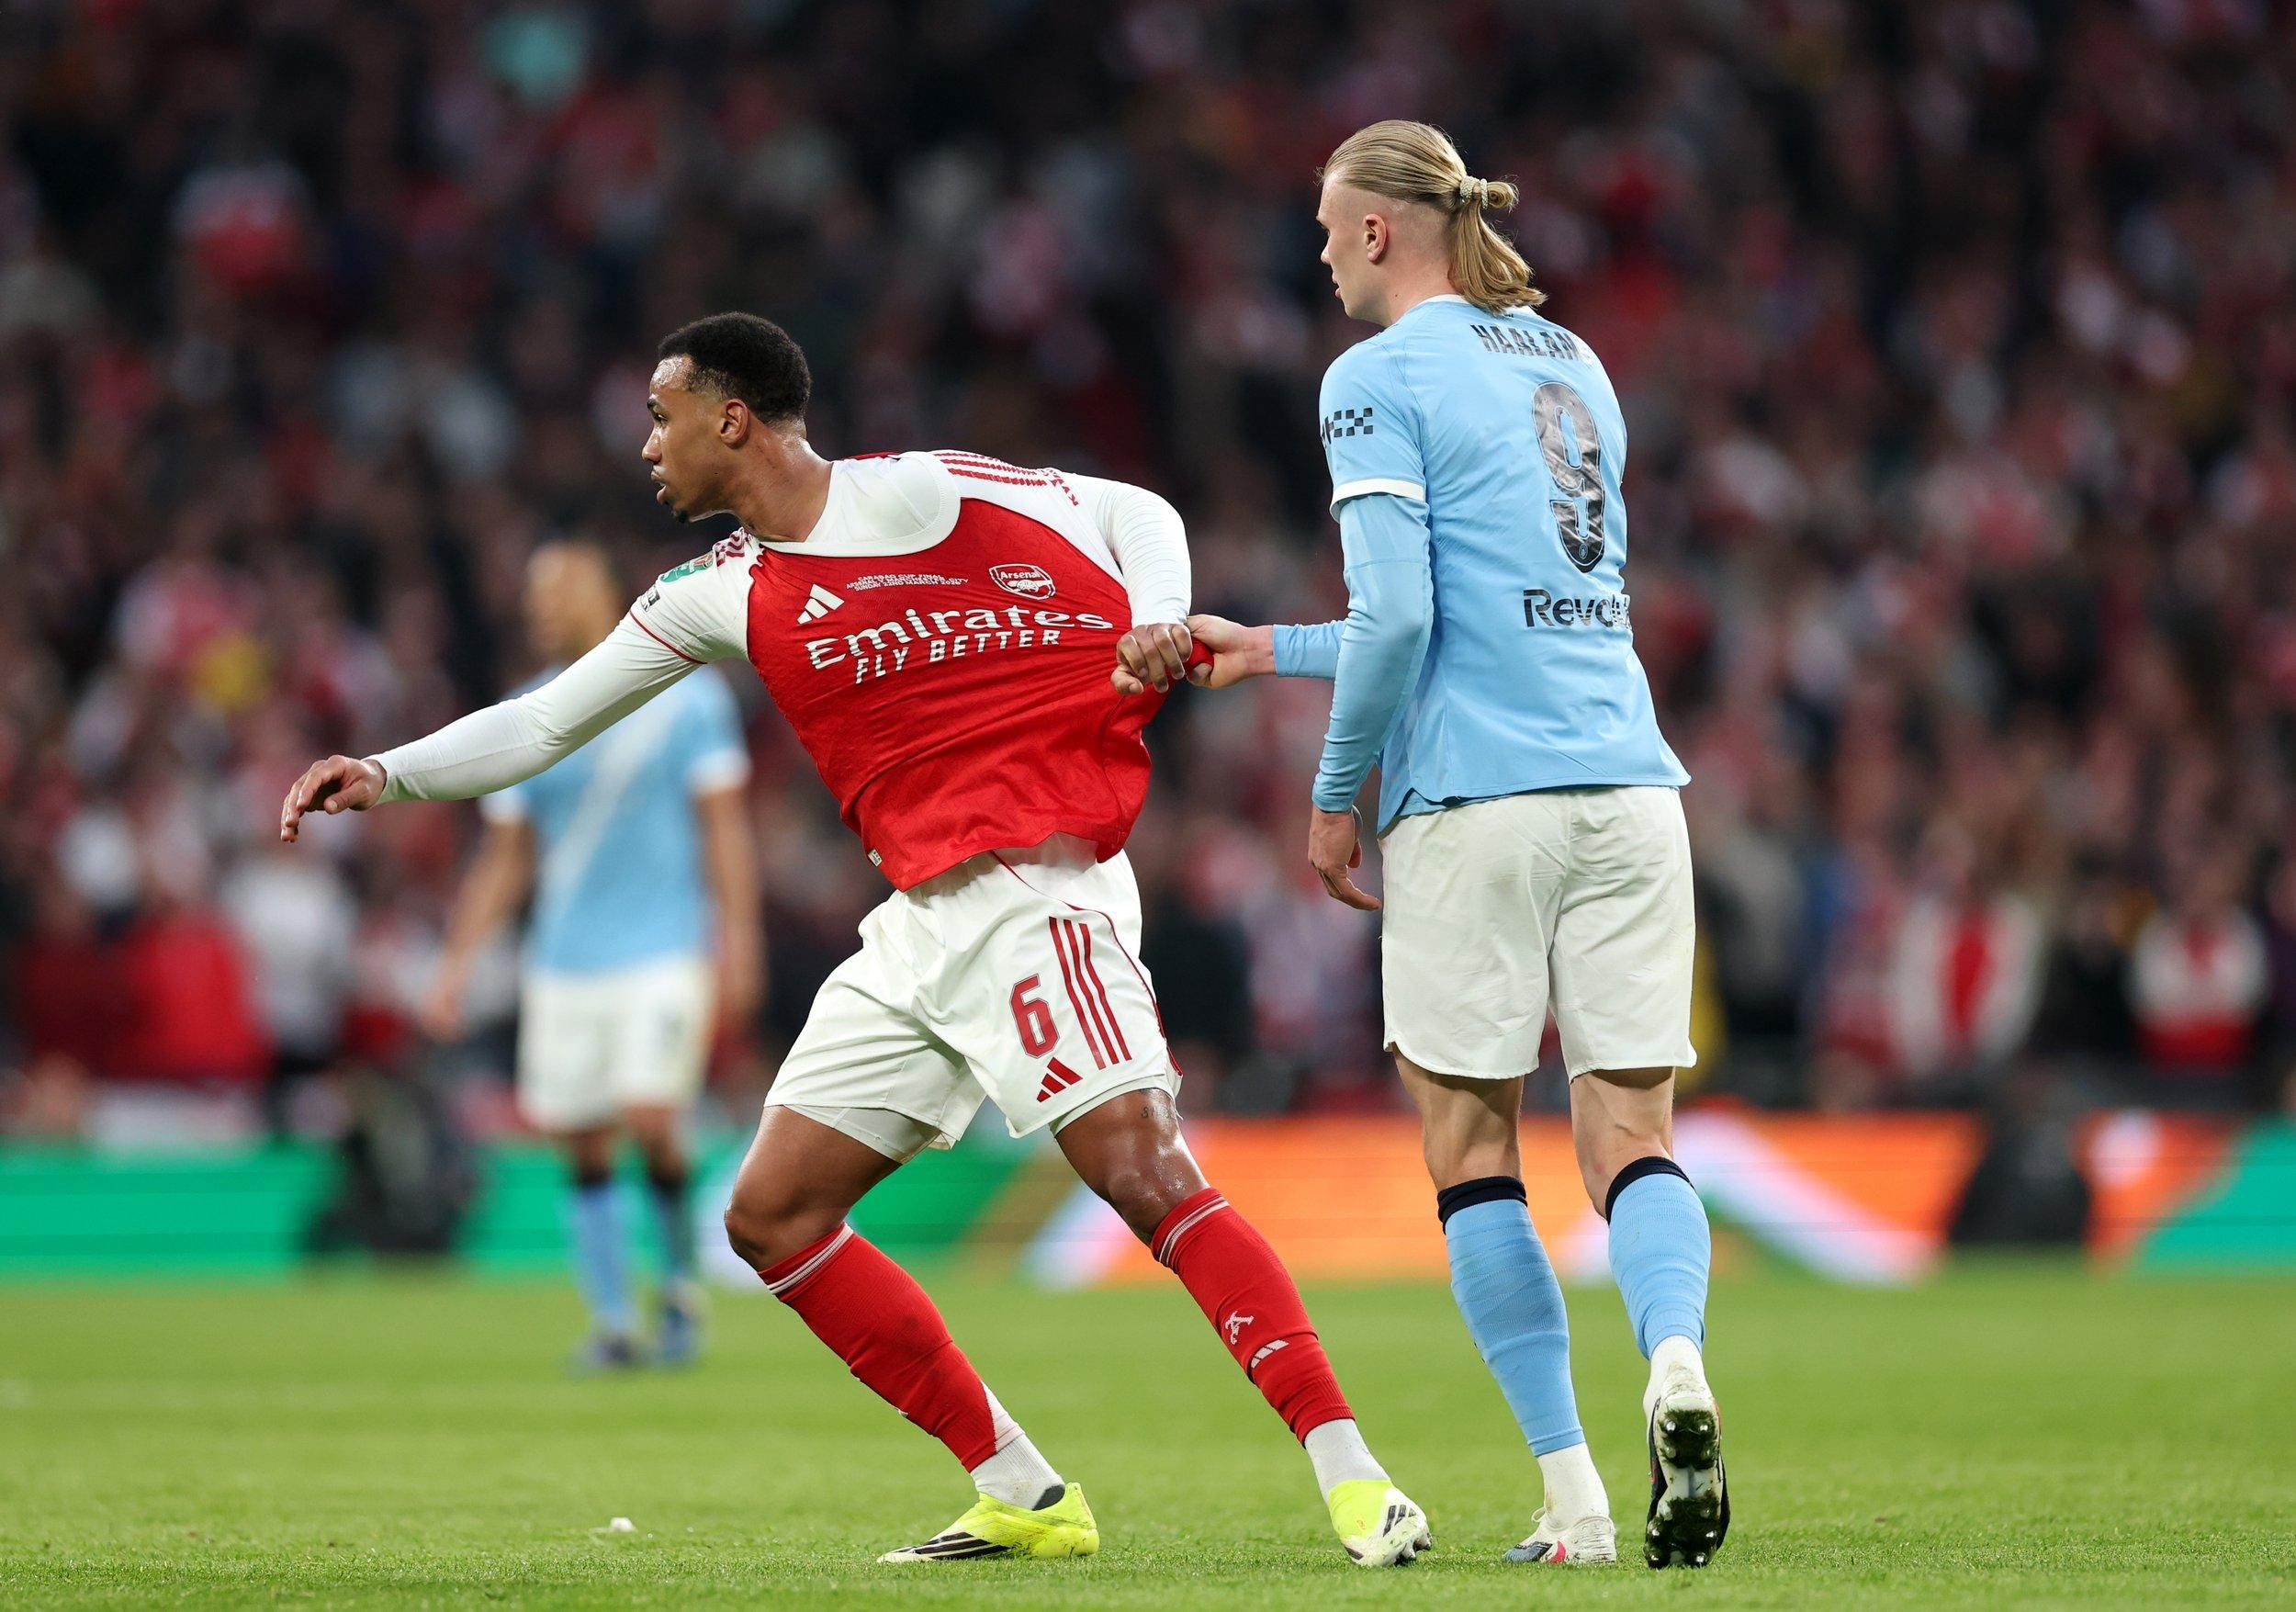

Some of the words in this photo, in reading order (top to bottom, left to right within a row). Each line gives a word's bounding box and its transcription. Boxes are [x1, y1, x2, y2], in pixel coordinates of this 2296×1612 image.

[1470, 324, 1596, 368] HAALAN
[1532, 380, 1605, 573] 9
[1000, 571, 1041, 580] Arsenal
[805, 604, 1113, 670] Emirates
[855, 647, 909, 684] FLY
[929, 629, 1061, 662] BETTER
[1009, 973, 1060, 1059] 6
